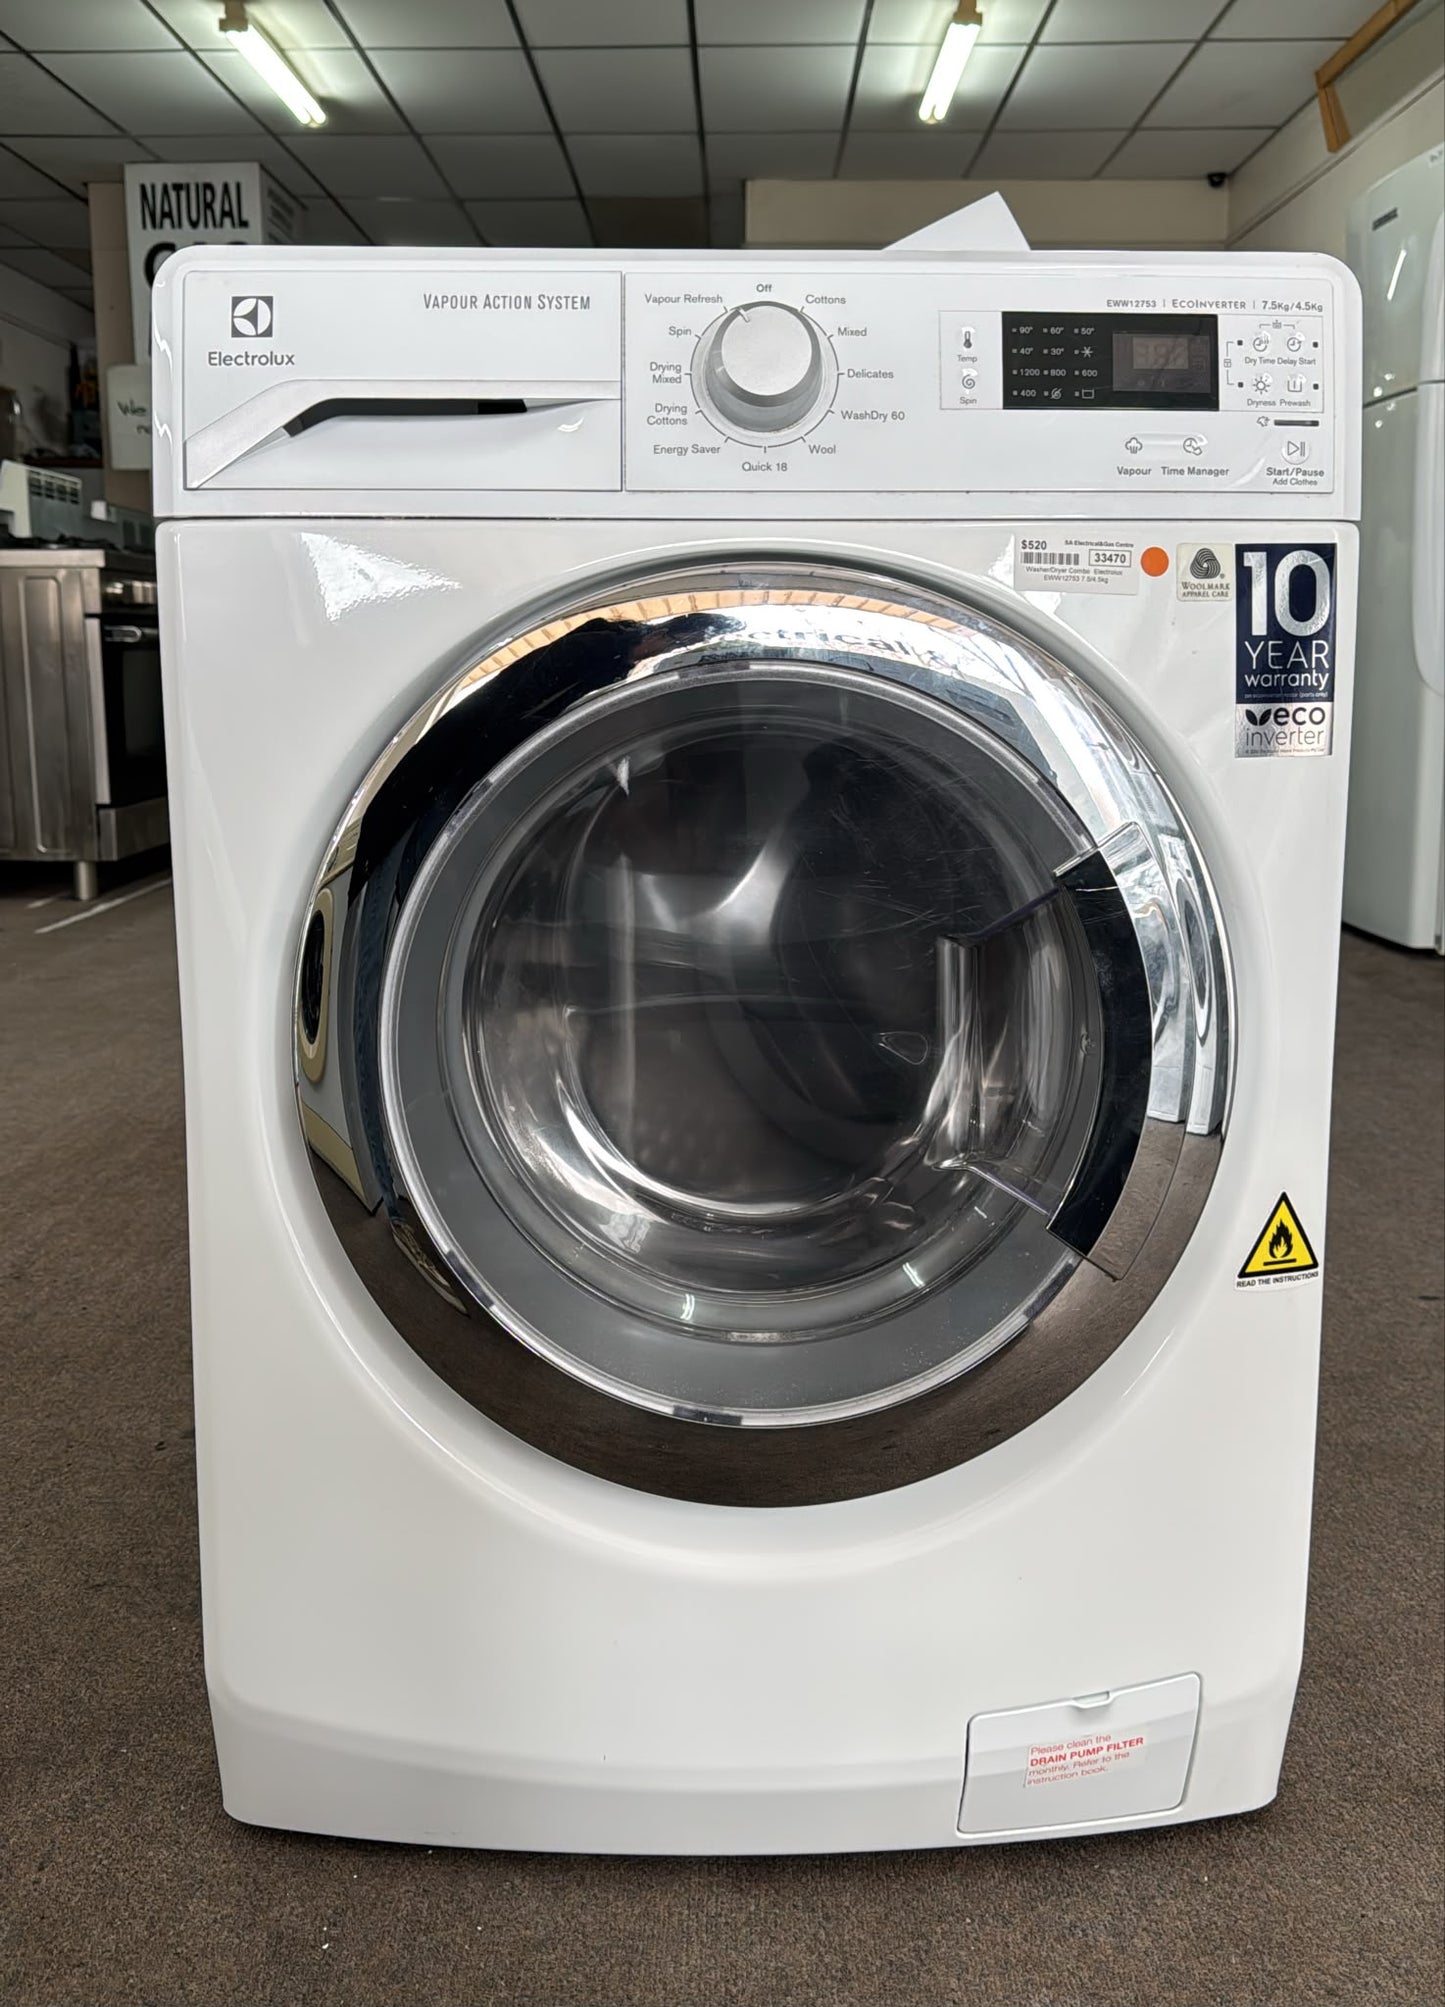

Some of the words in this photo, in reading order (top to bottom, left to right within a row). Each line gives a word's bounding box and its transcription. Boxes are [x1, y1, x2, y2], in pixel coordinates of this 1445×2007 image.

[140, 181, 249, 230] NATURAL
[756, 284, 773, 293] Off
[424, 294, 478, 310] VAPOUR
[483, 294, 532, 310] ACTION
[538, 294, 591, 310] SYSTEM
[645, 294, 681, 305] Vapour
[684, 294, 723, 304] Refresh
[805, 294, 846, 304] Cottons
[1106, 299, 1157, 309] EWW12753
[668, 326, 692, 338] Spin
[837, 327, 867, 337] Mixed
[208, 351, 295, 368] Electrolux
[957, 355, 978, 364] Temp
[1244, 356, 1257, 366] Dry
[1258, 356, 1276, 365] Time
[1277, 357, 1298, 366] Delay
[1298, 357, 1316, 365] Start
[650, 361, 682, 373] Drying
[1050, 369, 1067, 377] 800
[1081, 369, 1098, 377] 600
[652, 374, 682, 384] Mixed
[847, 368, 894, 379] Delicates
[1020, 389, 1037, 397] 400
[960, 396, 978, 406] Spin
[1246, 398, 1276, 408] Dryness
[1279, 399, 1311, 407] Prewash
[655, 403, 688, 415] Drying
[646, 416, 688, 426] Cottons
[841, 410, 888, 422] WashDry
[891, 411, 905, 421] 60
[653, 444, 689, 456] Energy
[691, 444, 721, 454] Saver
[808, 444, 836, 454] Wool
[742, 461, 772, 472] Quick
[776, 463, 788, 472] 18
[1117, 466, 1152, 477] Vapour
[1161, 466, 1185, 475] Time
[1187, 466, 1229, 478] Manager
[1266, 466, 1325, 478] Start/Pause
[1272, 478, 1288, 486] Add
[1289, 478, 1318, 487] Clothes
[1021, 539, 1048, 551] $520
[1094, 552, 1127, 564] 33470
[1068, 567, 1091, 575] Combo
[1093, 568, 1123, 576] Electrolux
[1181, 581, 1231, 591] WOOLMARK
[1243, 549, 1331, 637] 10
[1244, 639, 1330, 670] YEAR
[1244, 669, 1330, 691] warranty
[1273, 706, 1326, 727] eco
[1245, 727, 1325, 747] inverter
[1236, 1279, 1257, 1288] READ
[1258, 1277, 1272, 1286] THE
[1272, 1271, 1319, 1284] INSTRUCTIONS
[1030, 1744, 1064, 1756] Please
[1066, 1739, 1093, 1750] clean
[1095, 1734, 1112, 1745] the
[1030, 1753, 1067, 1767] DRAIN
[1069, 1745, 1104, 1760] PUMP
[1106, 1736, 1145, 1752] FILTER
[1028, 1763, 1070, 1777] monthly.
[1072, 1758, 1099, 1769] Refer
[1101, 1754, 1112, 1764] to
[1114, 1751, 1130, 1761] the
[1027, 1771, 1079, 1785] instruction
